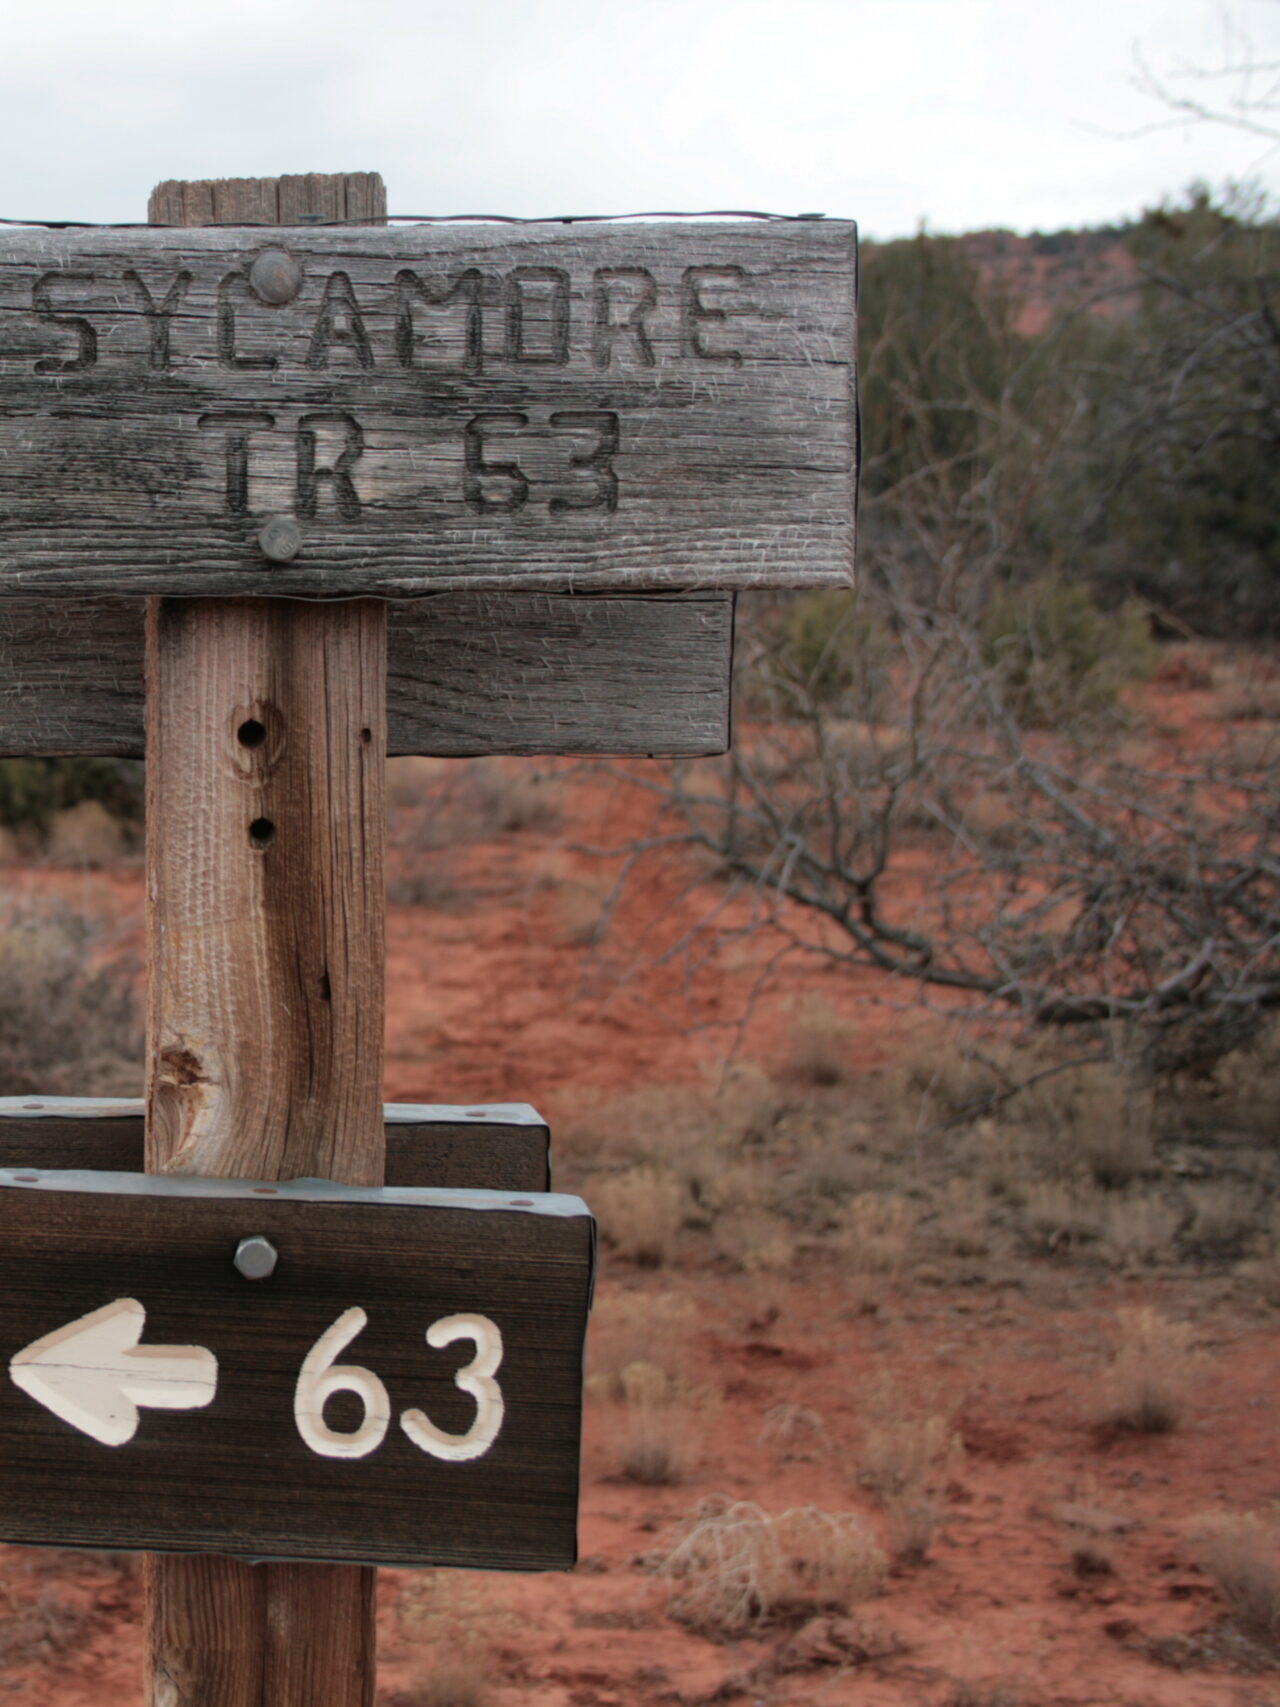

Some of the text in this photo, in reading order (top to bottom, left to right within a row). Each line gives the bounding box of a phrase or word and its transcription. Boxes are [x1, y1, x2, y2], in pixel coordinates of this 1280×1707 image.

[32, 266, 744, 376] SYCAMORE
[197, 410, 619, 520] TR 63
[294, 1307, 505, 1461] 63
